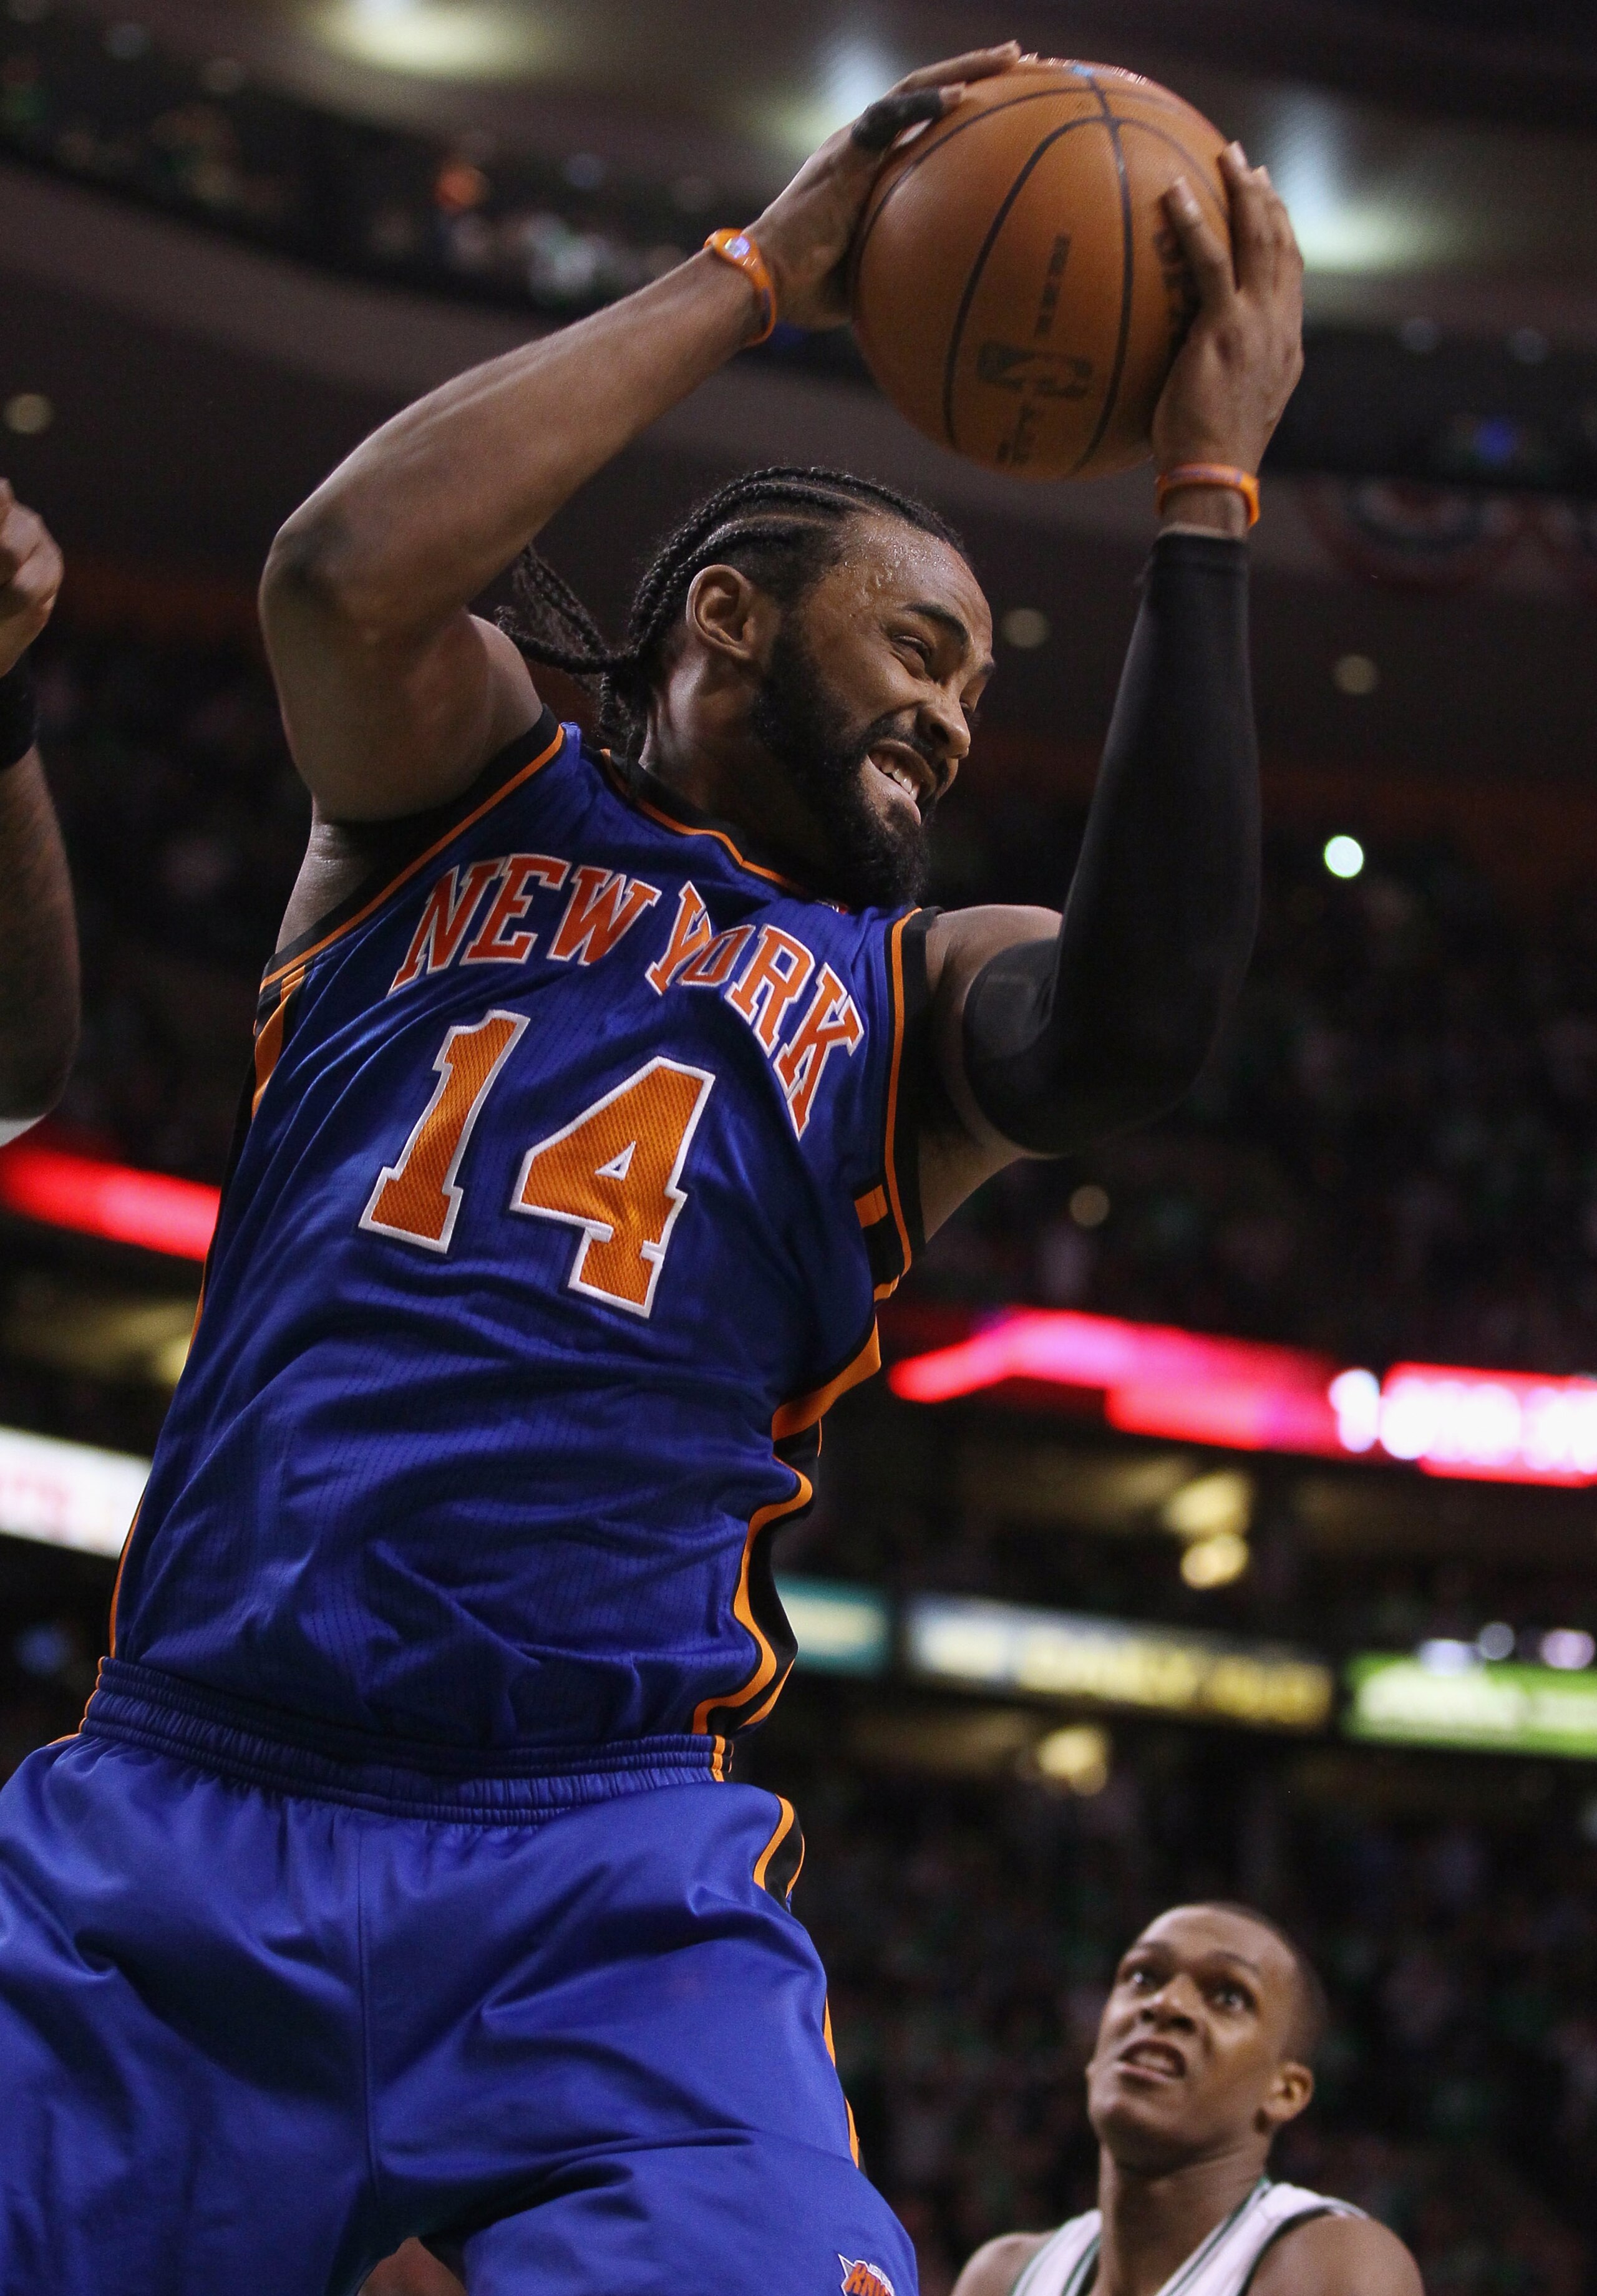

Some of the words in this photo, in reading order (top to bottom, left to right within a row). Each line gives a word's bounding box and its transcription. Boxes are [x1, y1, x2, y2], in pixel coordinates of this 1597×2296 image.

[387, 853, 661, 997] NEW
[646, 880, 865, 1141] YORK
[358, 1009, 716, 1319] 14
